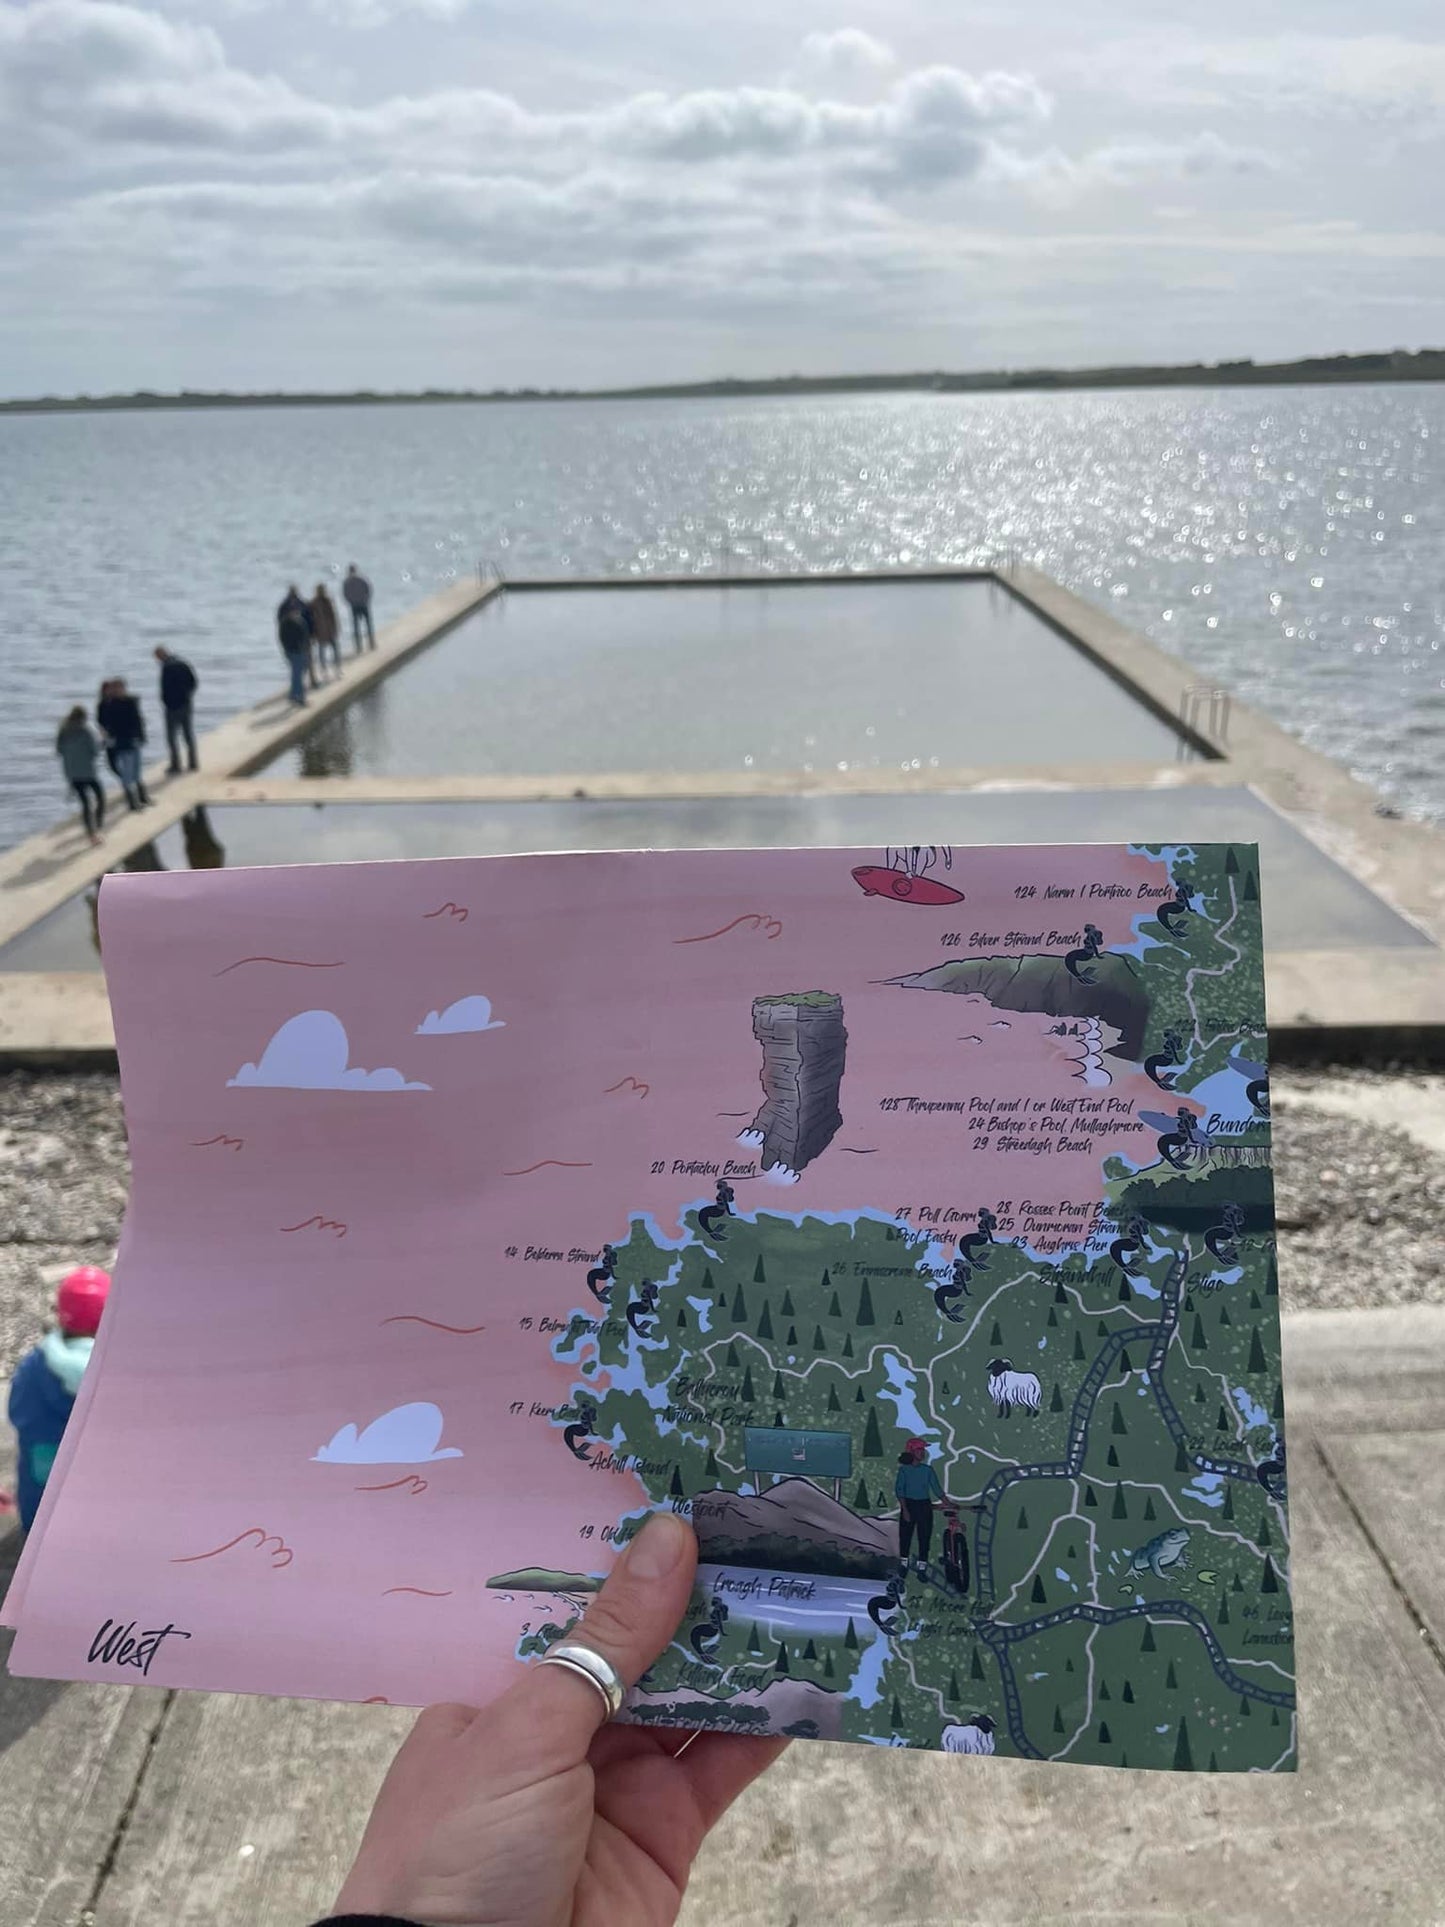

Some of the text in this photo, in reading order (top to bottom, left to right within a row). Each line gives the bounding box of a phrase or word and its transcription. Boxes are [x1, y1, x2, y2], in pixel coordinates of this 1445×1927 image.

[1014, 885, 1037, 899] 124
[1089, 883, 1133, 900] Portnoo
[1137, 883, 1172, 900] Beach
[941, 930, 1082, 948] 126 Silver Strand Beach
[880, 1098, 899, 1111] 128
[969, 1096, 996, 1113] Pool
[997, 1098, 1022, 1113] and
[1033, 1101, 1046, 1112] or
[1050, 1097, 1078, 1114] West
[1078, 1097, 1105, 1113] End
[1107, 1097, 1134, 1114] Pool
[968, 1117, 986, 1130] 24
[987, 1116, 1038, 1134] Bishop's
[1070, 1118, 1144, 1136] Mullaghmore
[973, 1136, 1093, 1155] 29 Streedagh Beach
[651, 1160, 665, 1174] 20
[723, 1159, 756, 1176] Beach
[895, 1207, 912, 1221] 27
[919, 1206, 942, 1224] Poll
[997, 1201, 1012, 1214] 28
[1019, 1200, 1053, 1216] Rosses
[1058, 1201, 1092, 1218] Point
[999, 1218, 1015, 1232] 25
[897, 1227, 957, 1246] Pool Easky
[1012, 1235, 1028, 1249] 23
[1083, 1236, 1108, 1252] Pier
[567, 1247, 602, 1263] Strand
[918, 1262, 953, 1280] Beach
[1187, 1272, 1223, 1299] Sligo
[519, 1317, 533, 1330] 15
[509, 1402, 524, 1415] 17
[589, 1450, 673, 1476] Achill Island
[671, 1497, 737, 1521] Westport
[579, 1525, 594, 1539] 19
[713, 1572, 816, 1601] Croagh Patrick
[88, 1619, 191, 1676] West
